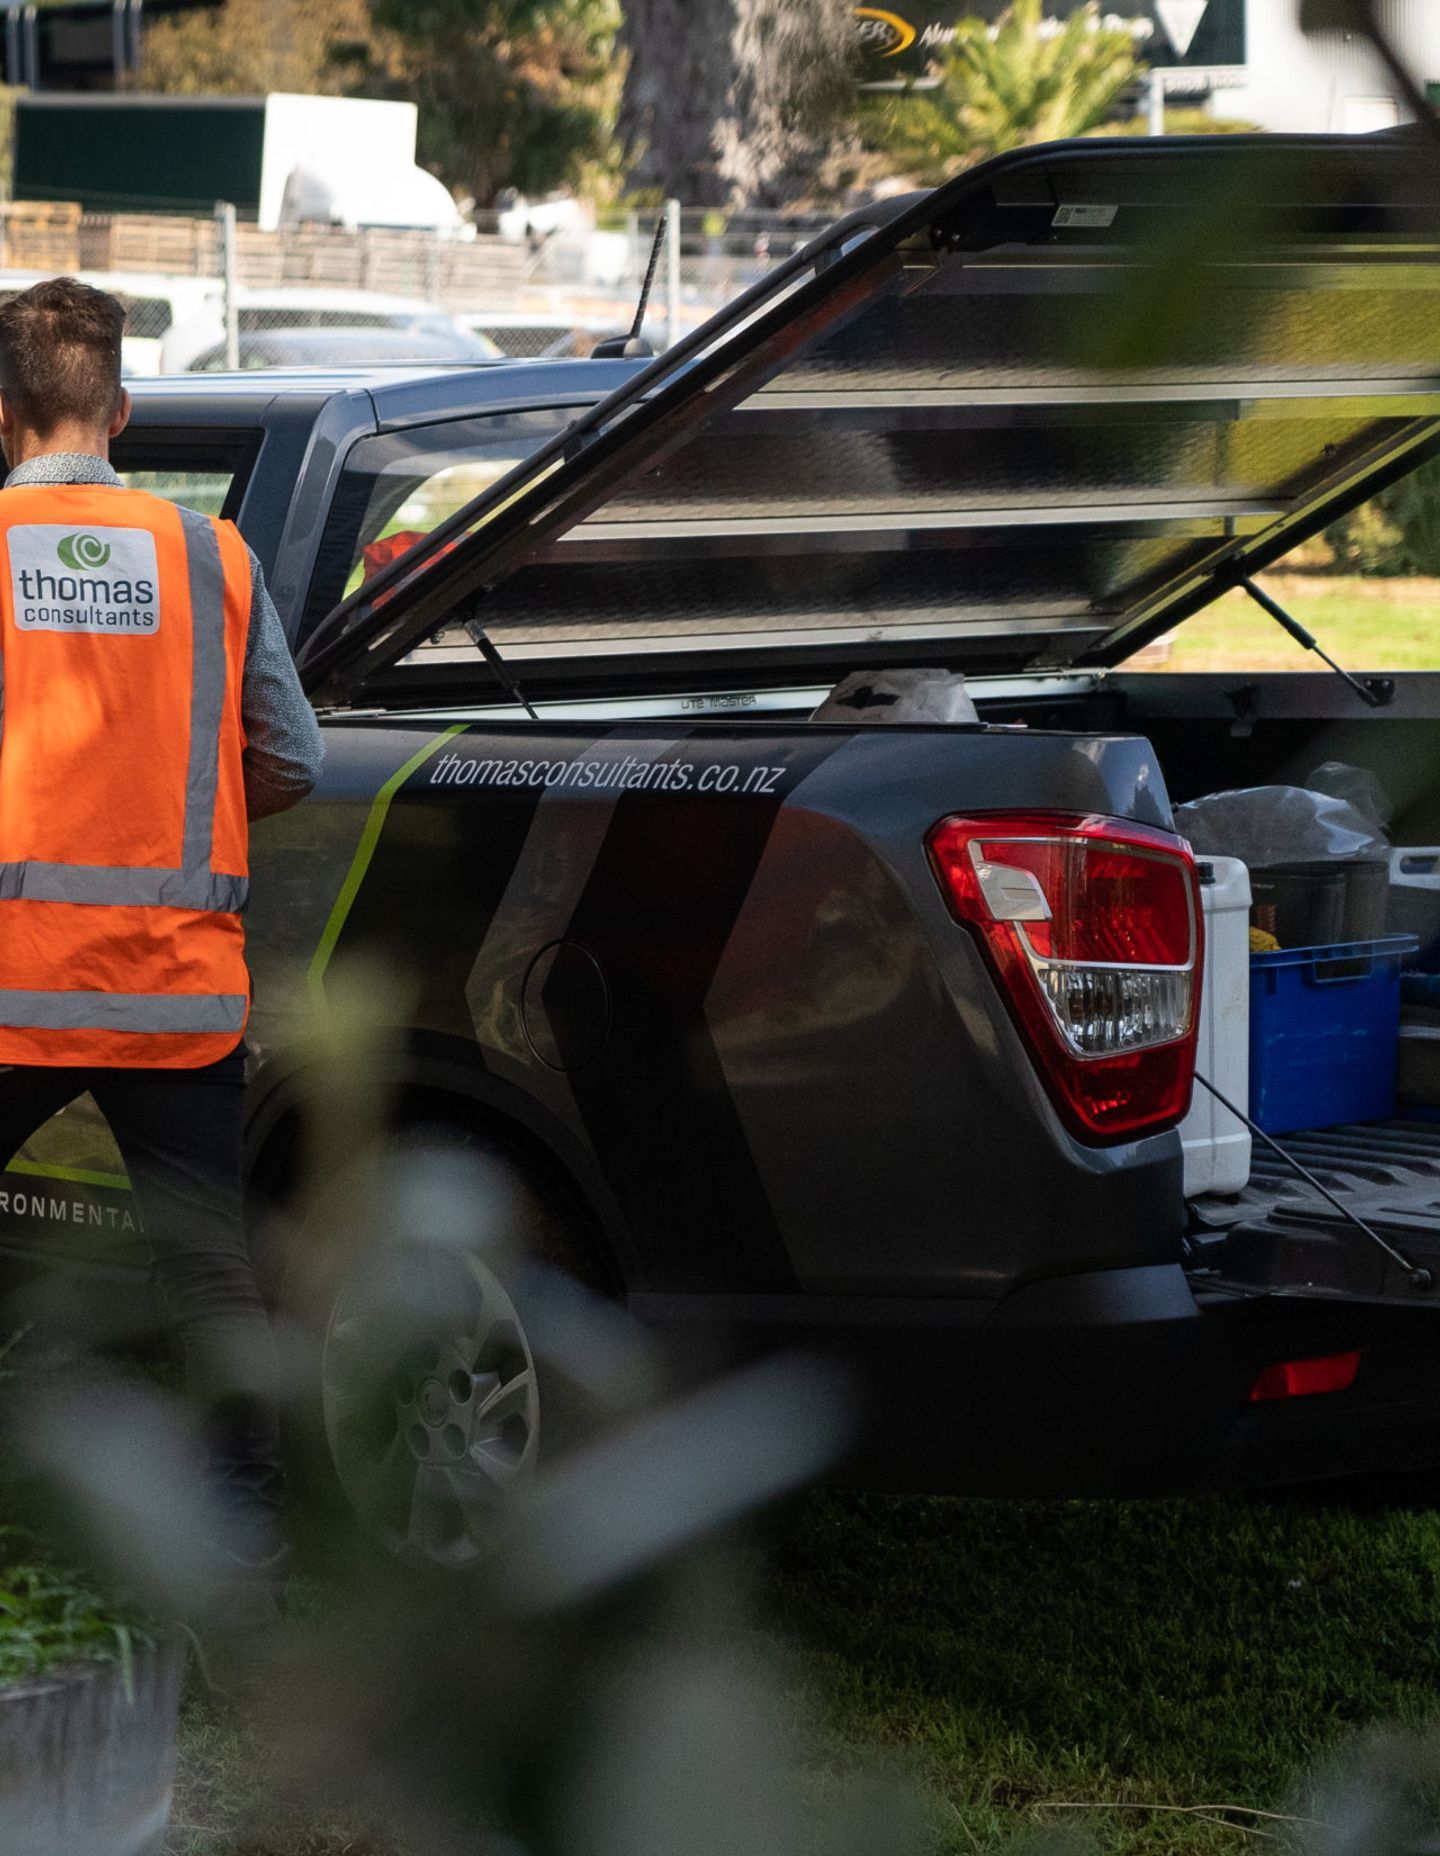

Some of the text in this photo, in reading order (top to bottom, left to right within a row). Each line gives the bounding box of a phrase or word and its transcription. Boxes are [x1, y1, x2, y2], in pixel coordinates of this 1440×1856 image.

[19, 569, 153, 604] thomas
[24, 605, 154, 627] consultants
[429, 753, 787, 794] thomasconsultants.co.nz
